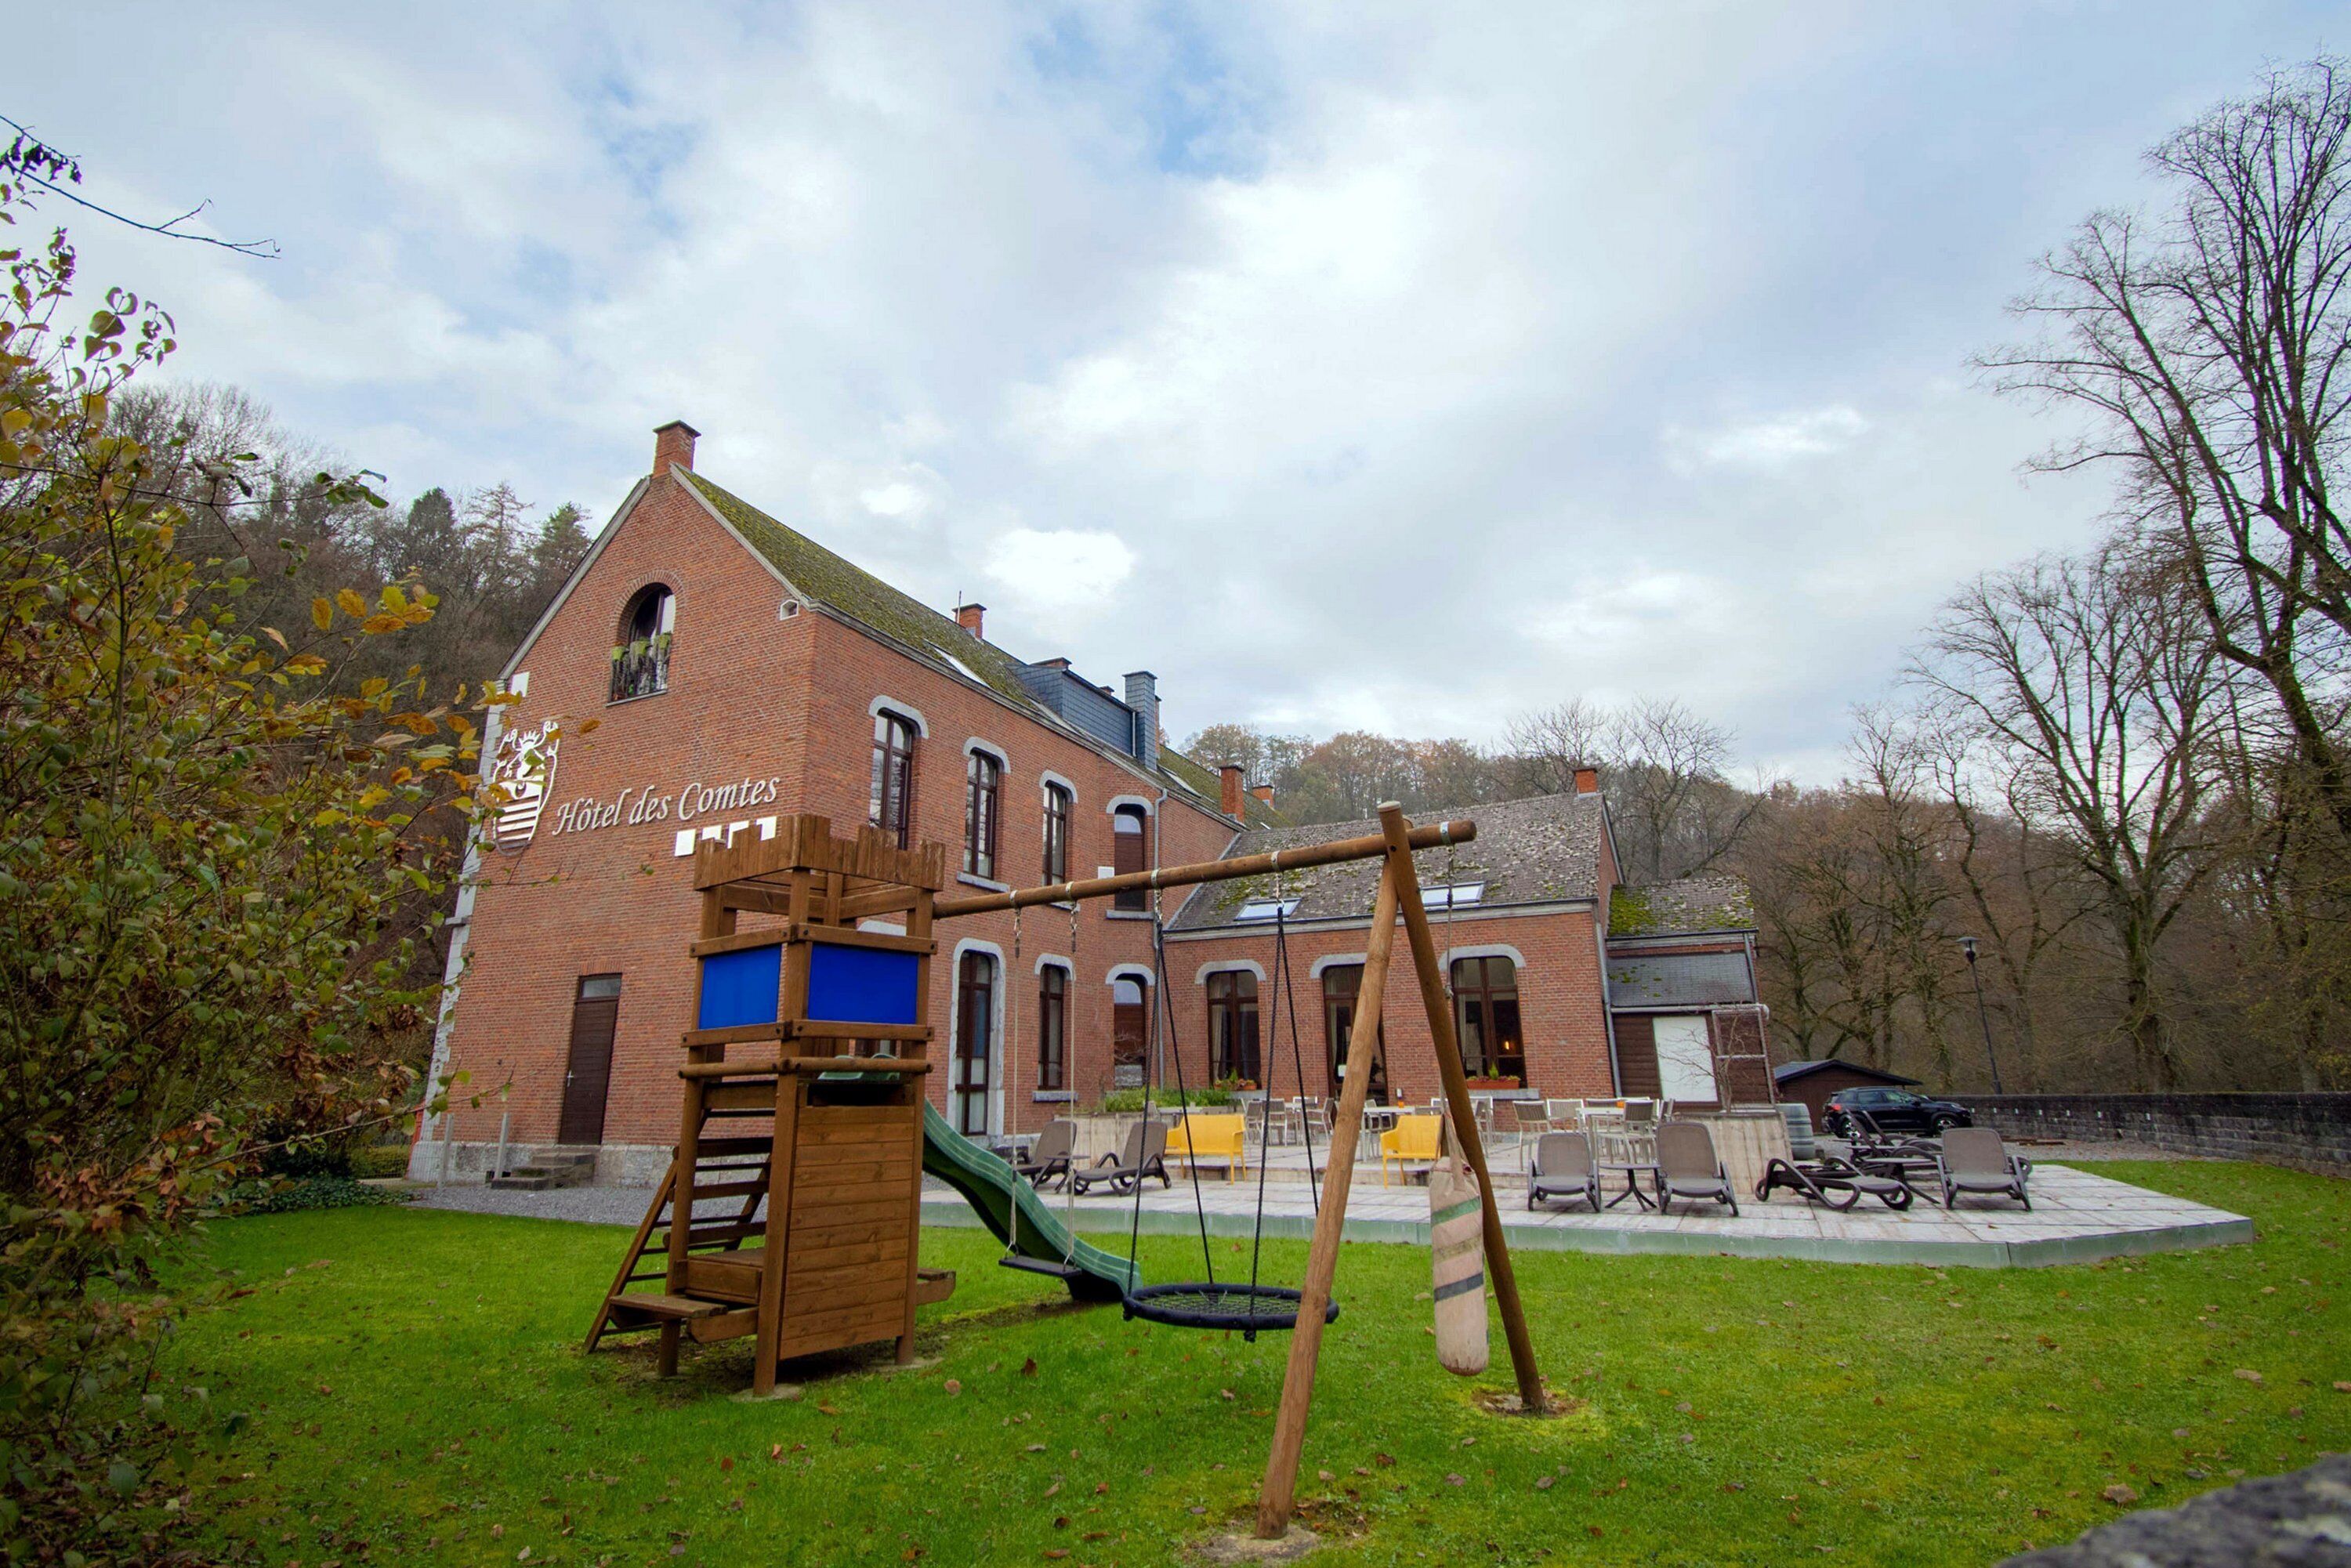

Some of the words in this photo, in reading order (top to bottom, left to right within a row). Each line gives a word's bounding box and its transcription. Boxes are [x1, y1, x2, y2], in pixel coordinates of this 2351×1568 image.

[552, 788, 632, 836] Hôtel
[629, 784, 672, 824] des
[679, 777, 780, 820] Comtes
